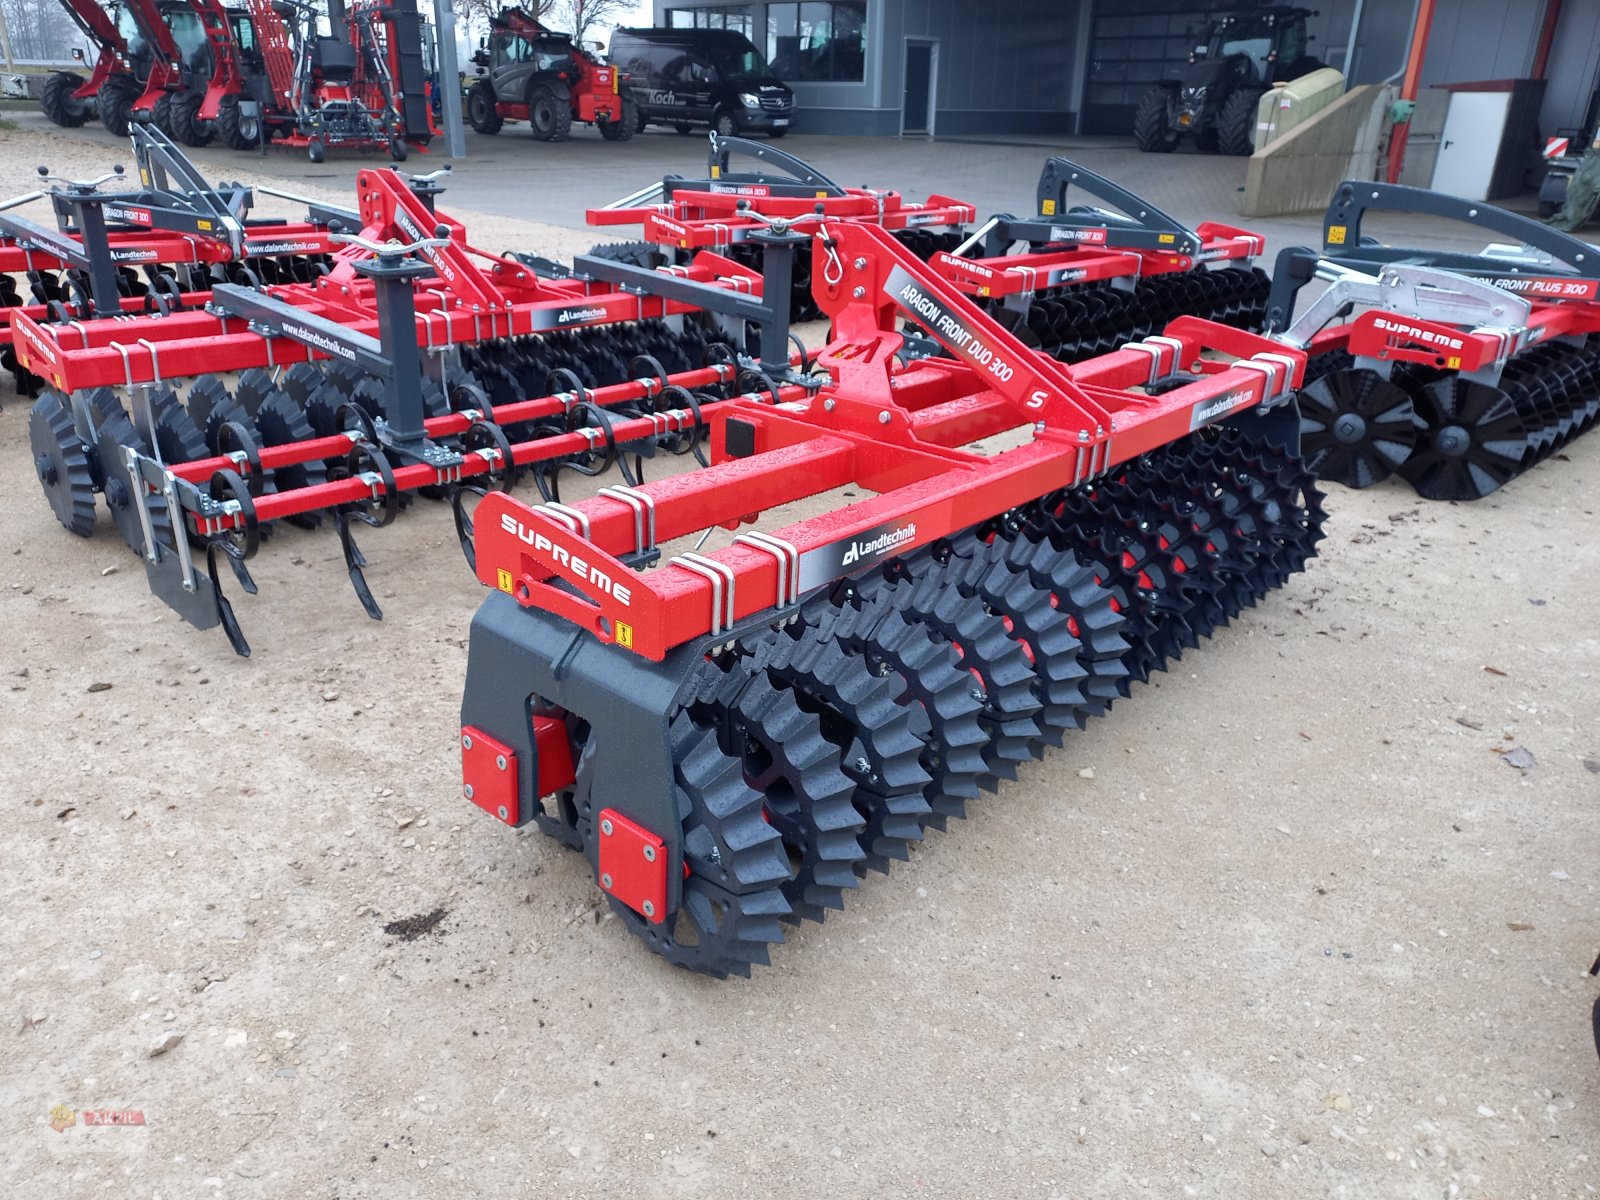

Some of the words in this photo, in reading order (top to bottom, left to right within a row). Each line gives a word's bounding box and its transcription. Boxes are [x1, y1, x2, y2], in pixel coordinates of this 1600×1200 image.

[649, 90, 675, 105] Koch
[104, 207, 123, 218] DRAGON
[124, 210, 138, 220] FRONT
[138, 212, 149, 222] 300
[401, 216, 421, 242] ARAGON
[115, 249, 159, 260] Landtechnik
[247, 241, 321, 253] www.dalandtechnik.com
[940, 254, 993, 279] SUPREME
[1495, 278, 1532, 291] FRONT
[1532, 281, 1562, 293] PLUS
[1563, 284, 1588, 295] 300
[281, 321, 356, 361] www.dalandtechnik.com
[899, 283, 942, 323] ARAGON
[936, 314, 973, 347] FRONT
[967, 341, 993, 366] DUO
[987, 357, 1014, 382] 300
[1373, 317, 1464, 350] SUPREME
[859, 523, 916, 556] Landtechnik
[501, 513, 632, 607] SUPREME
